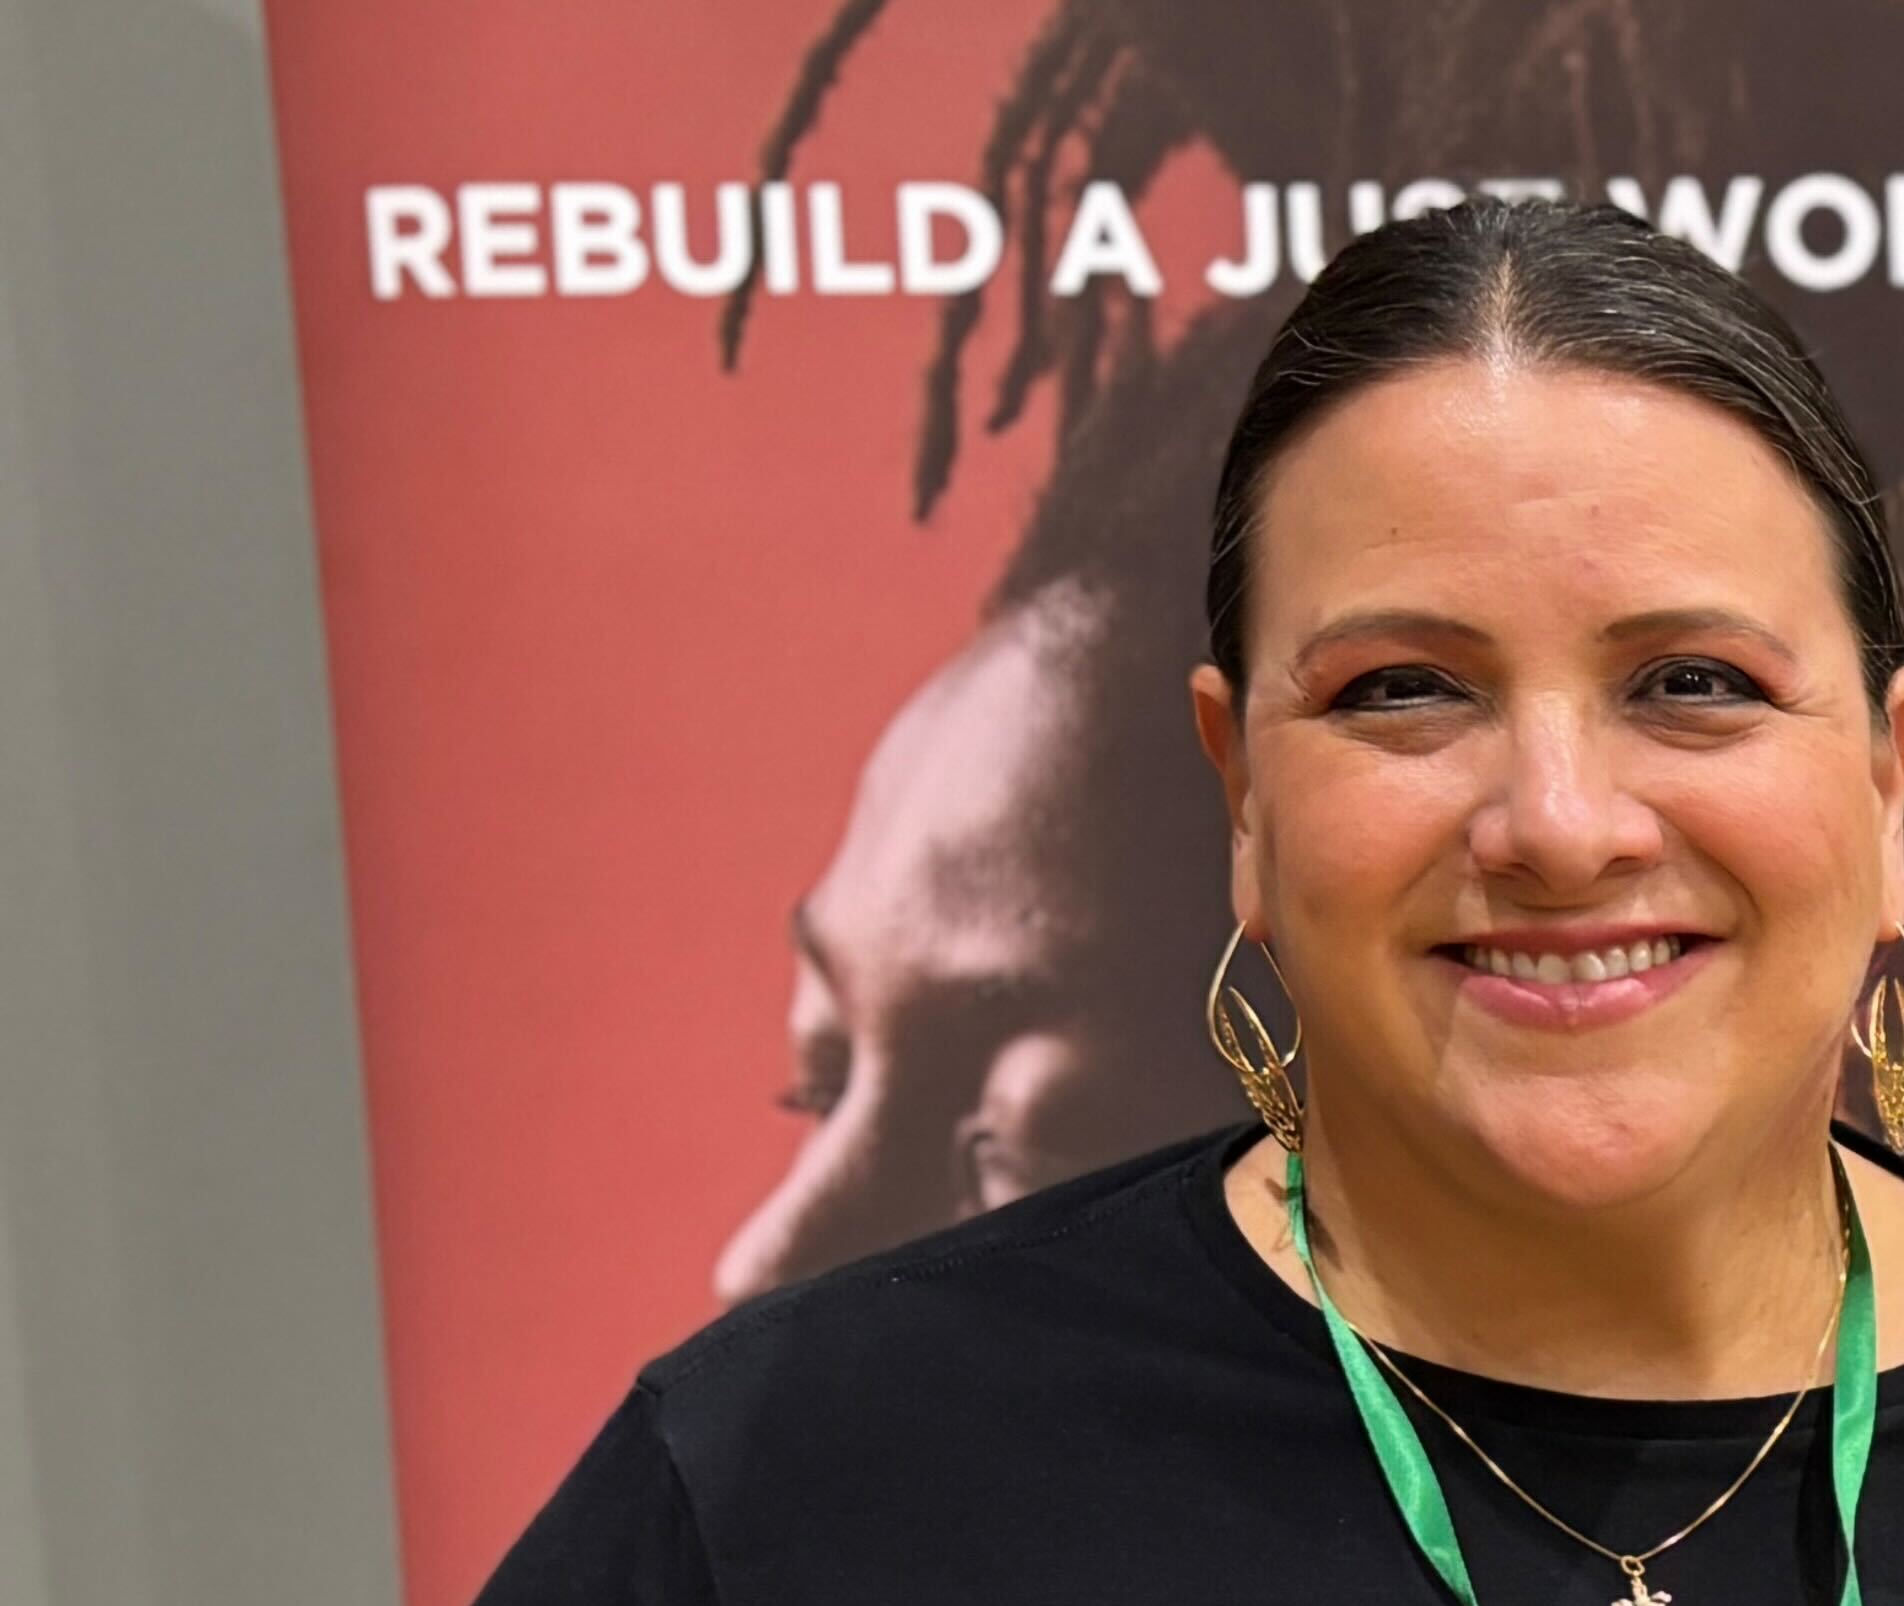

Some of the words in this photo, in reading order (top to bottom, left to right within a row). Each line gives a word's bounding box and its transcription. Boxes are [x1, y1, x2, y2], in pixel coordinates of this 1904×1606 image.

[365, 181, 1002, 298] REBUILD
[1053, 183, 1163, 295] A
[1205, 179, 1565, 298] JU
